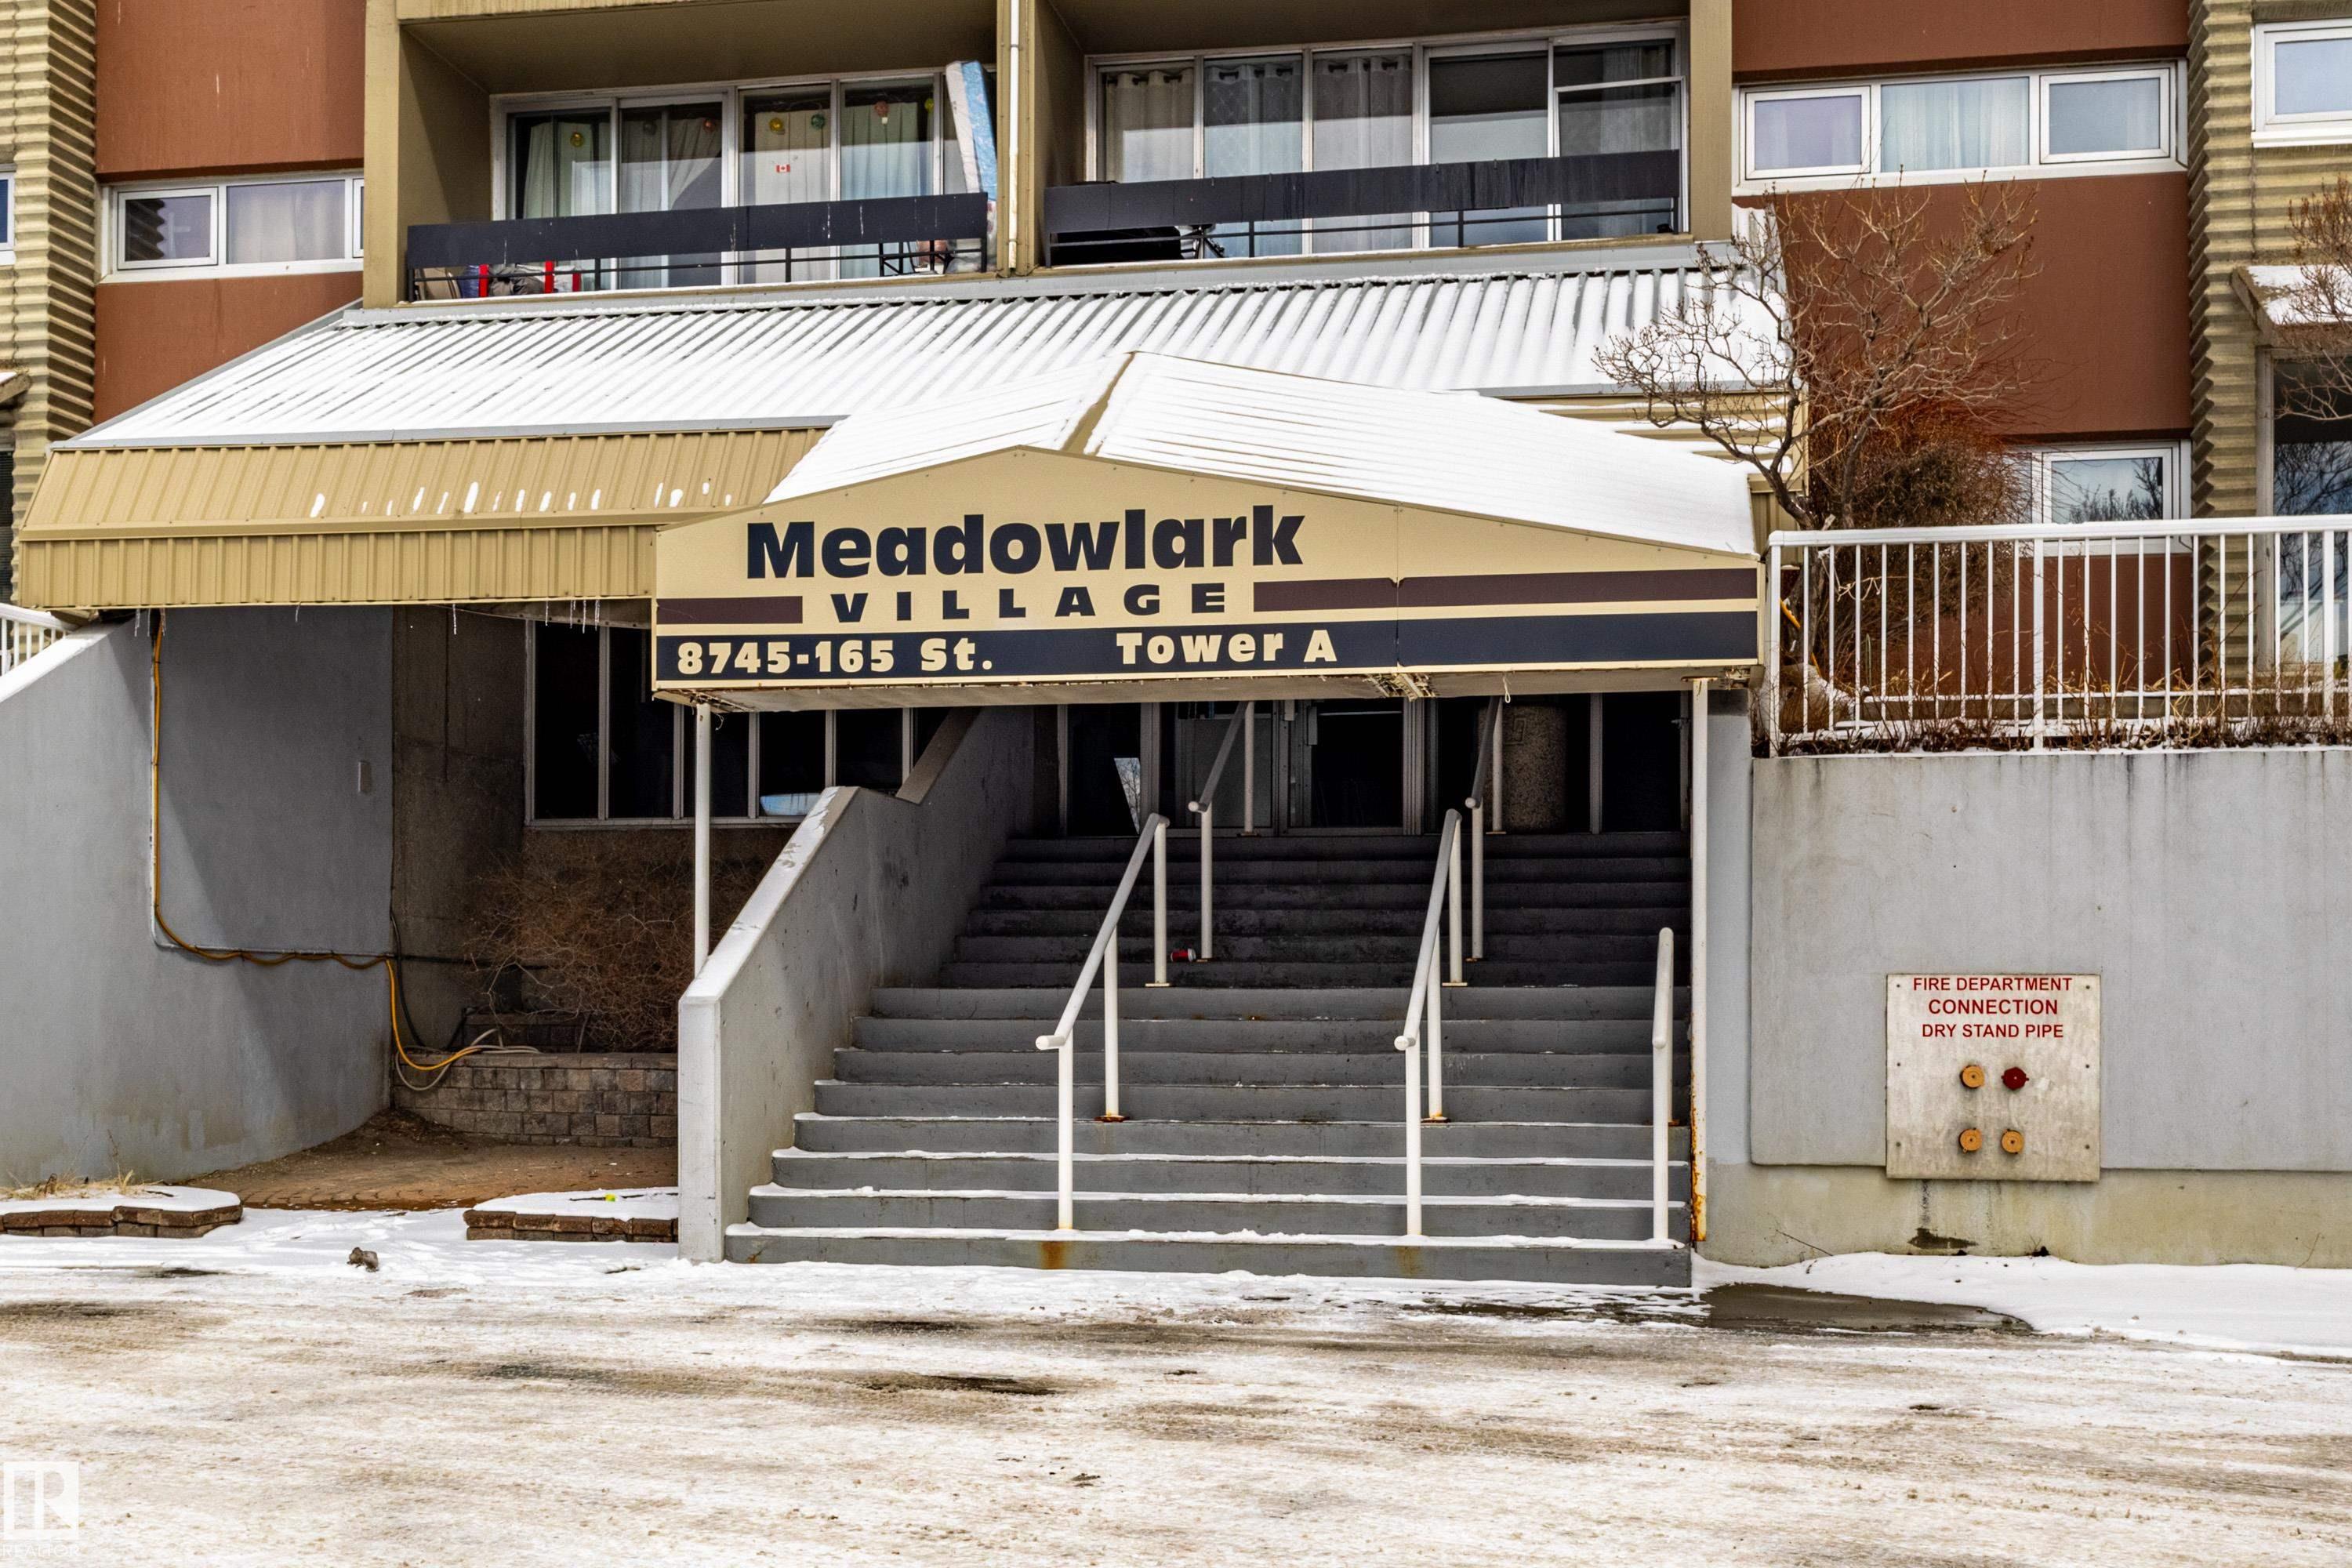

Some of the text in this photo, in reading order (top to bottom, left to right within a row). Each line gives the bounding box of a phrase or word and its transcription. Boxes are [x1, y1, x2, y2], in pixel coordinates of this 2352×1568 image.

[746, 504, 1306, 579] Meadowlark
[830, 582, 1225, 623] VILLAGE
[677, 637, 993, 675] 8745-165 St.
[1116, 629, 1338, 665] Tower A
[1913, 978, 2072, 991] FIRE DEPARTMENT
[1928, 999, 2058, 1014] CONNECTION
[1922, 1024, 2063, 1038] DRY STAND PIPE
